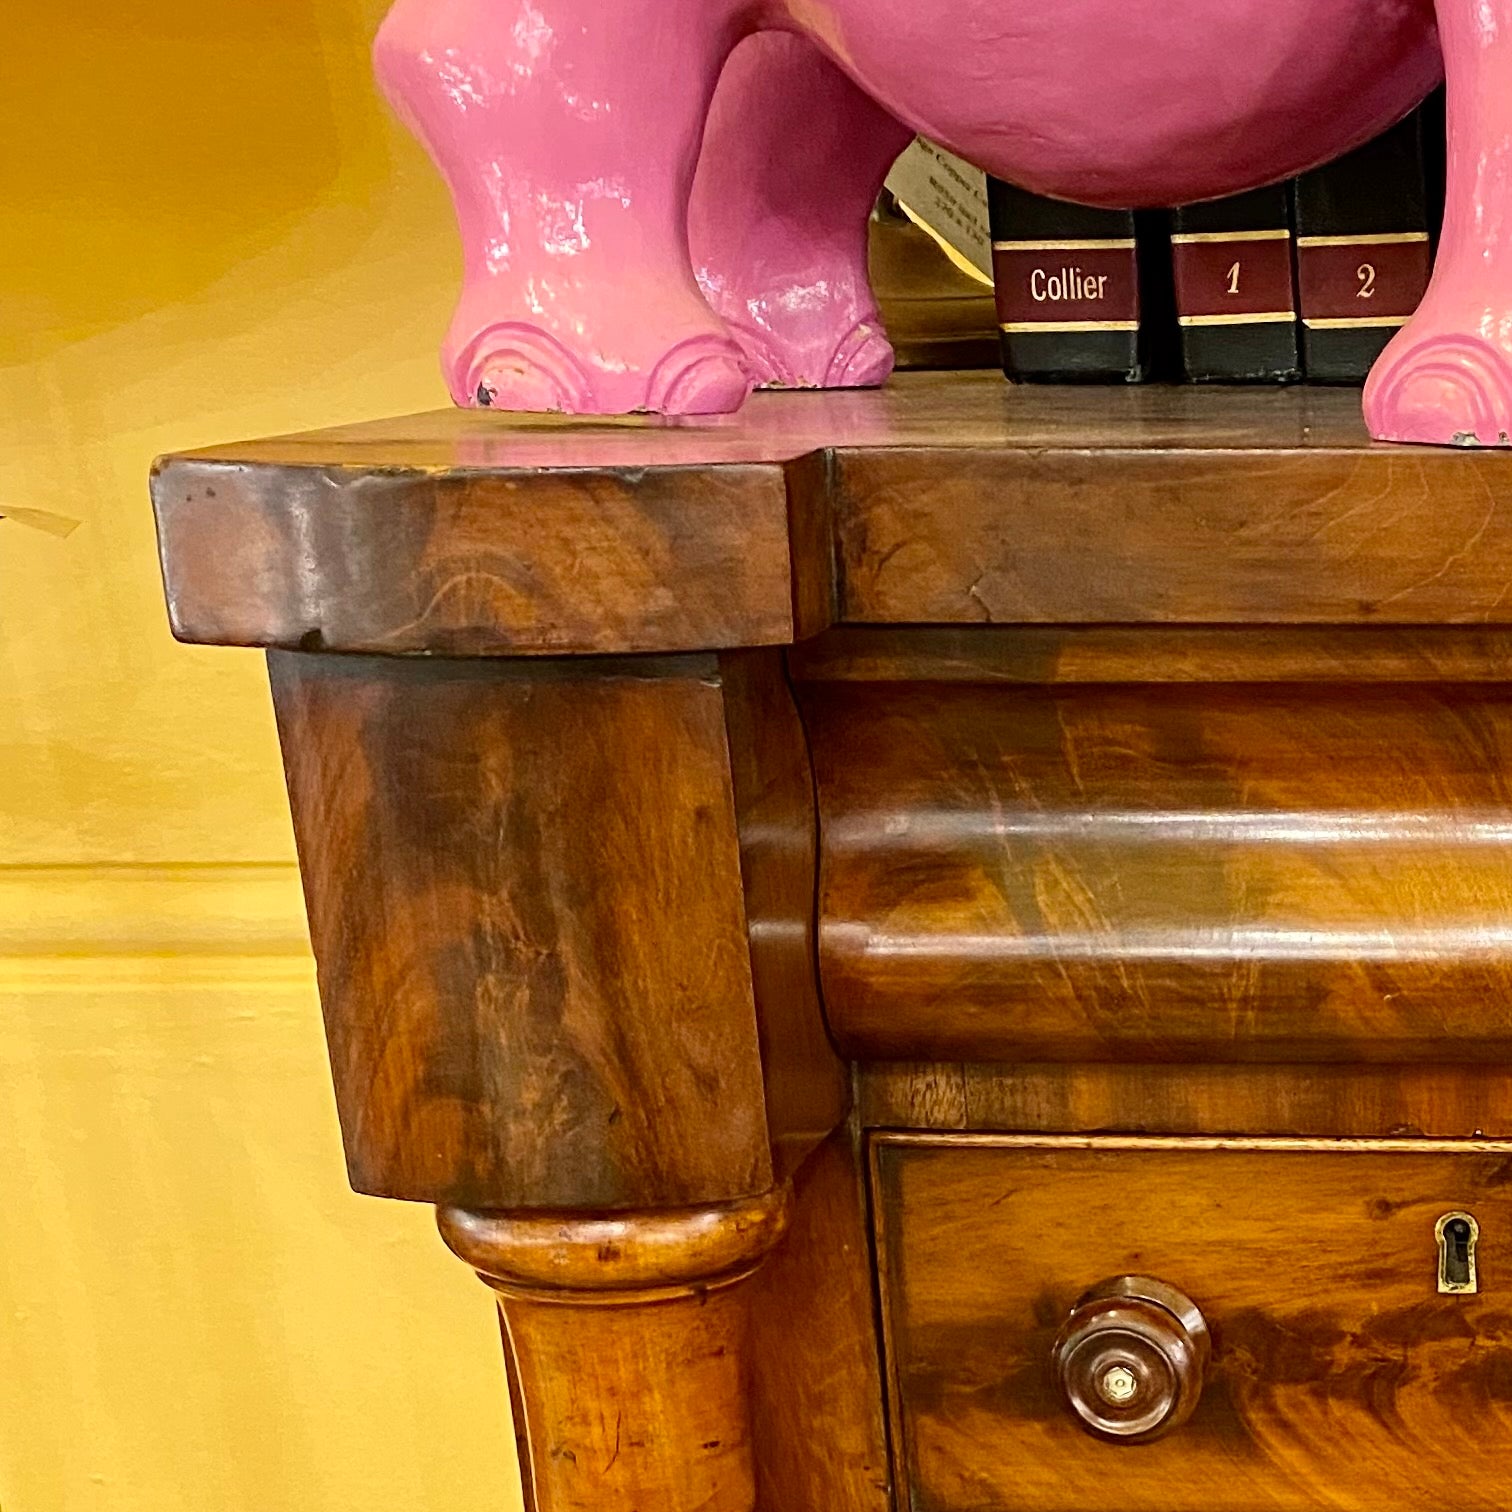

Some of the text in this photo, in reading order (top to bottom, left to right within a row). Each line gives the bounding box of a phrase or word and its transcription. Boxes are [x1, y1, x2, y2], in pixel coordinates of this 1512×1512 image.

[1031, 267, 1108, 301] Collier
[1226, 261, 1240, 294] 1
[1356, 263, 1376, 298] 2
